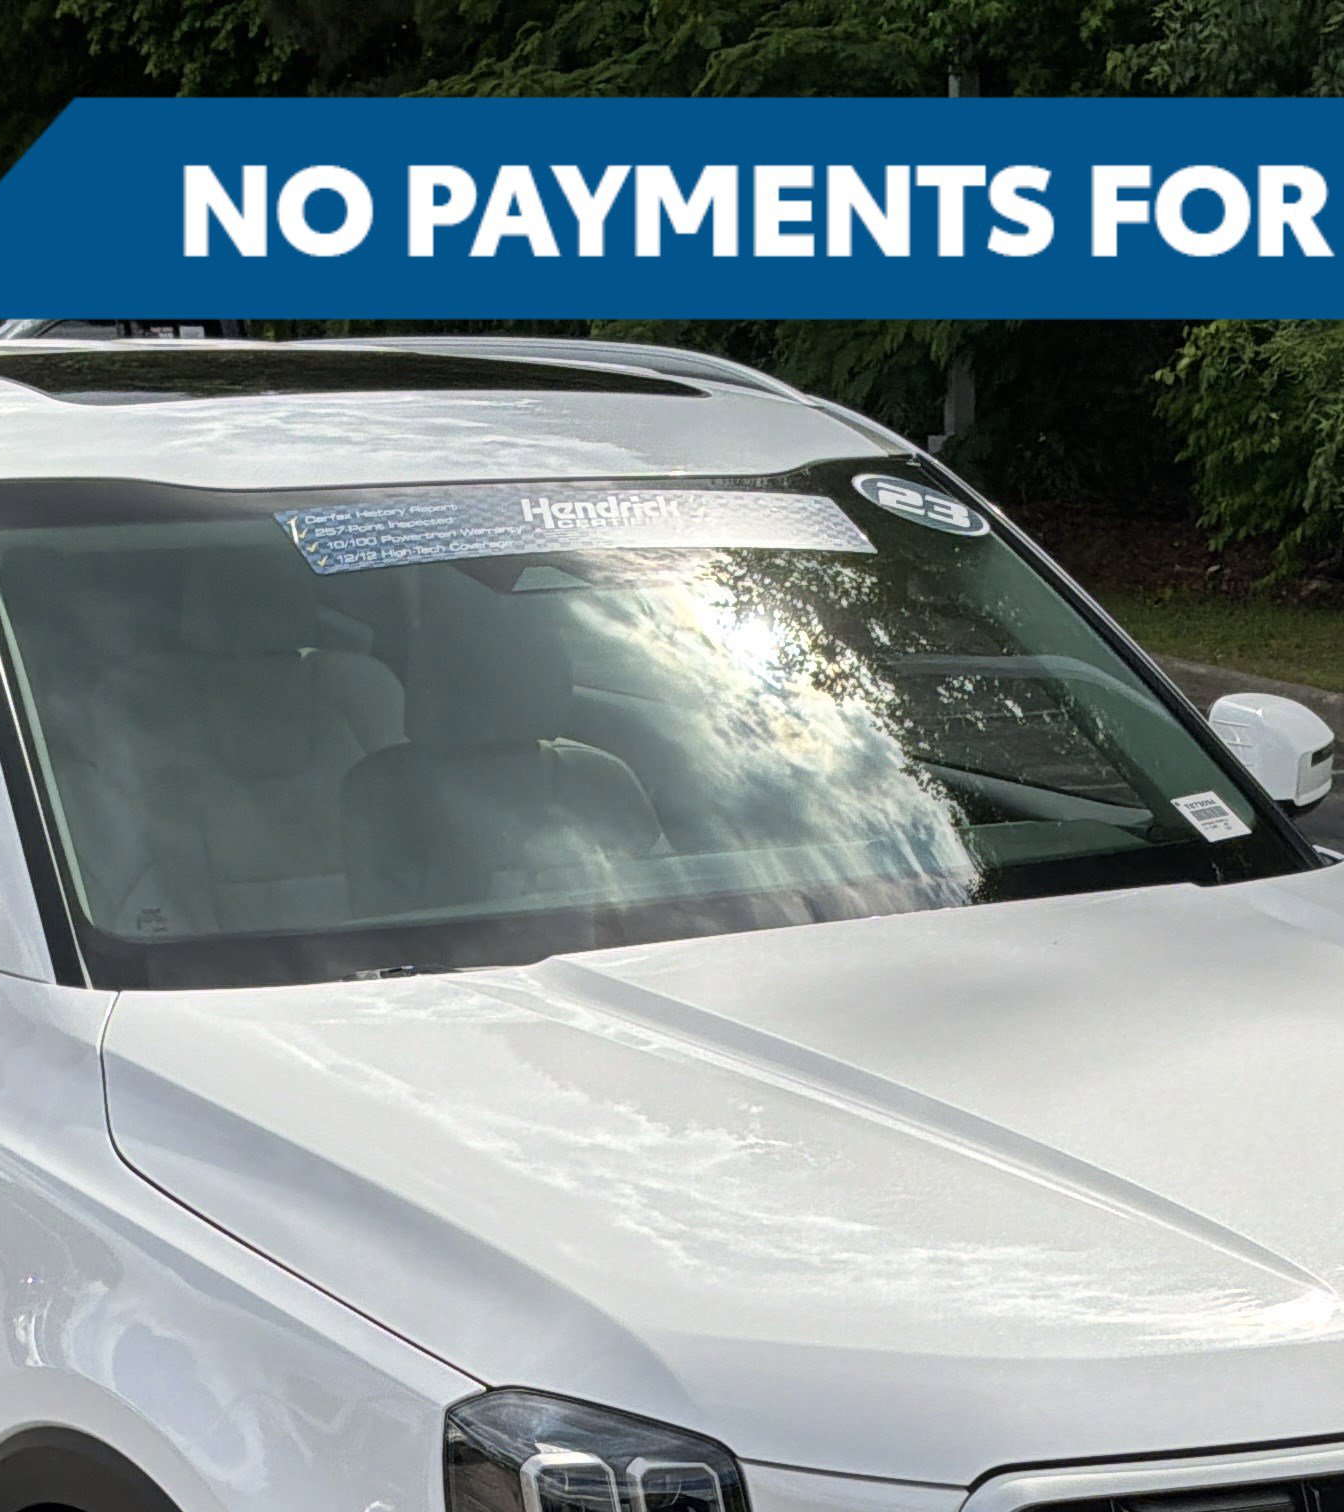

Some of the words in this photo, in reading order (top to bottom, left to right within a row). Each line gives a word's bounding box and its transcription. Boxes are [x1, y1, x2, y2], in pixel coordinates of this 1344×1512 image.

[304, 512, 352, 525] Carfax
[356, 507, 406, 519] History
[409, 503, 457, 514] Report
[521, 496, 680, 529] Hendrick
[876, 481, 971, 528] 23
[326, 536, 377, 551] 10/100
[336, 550, 378, 564] 12/12
